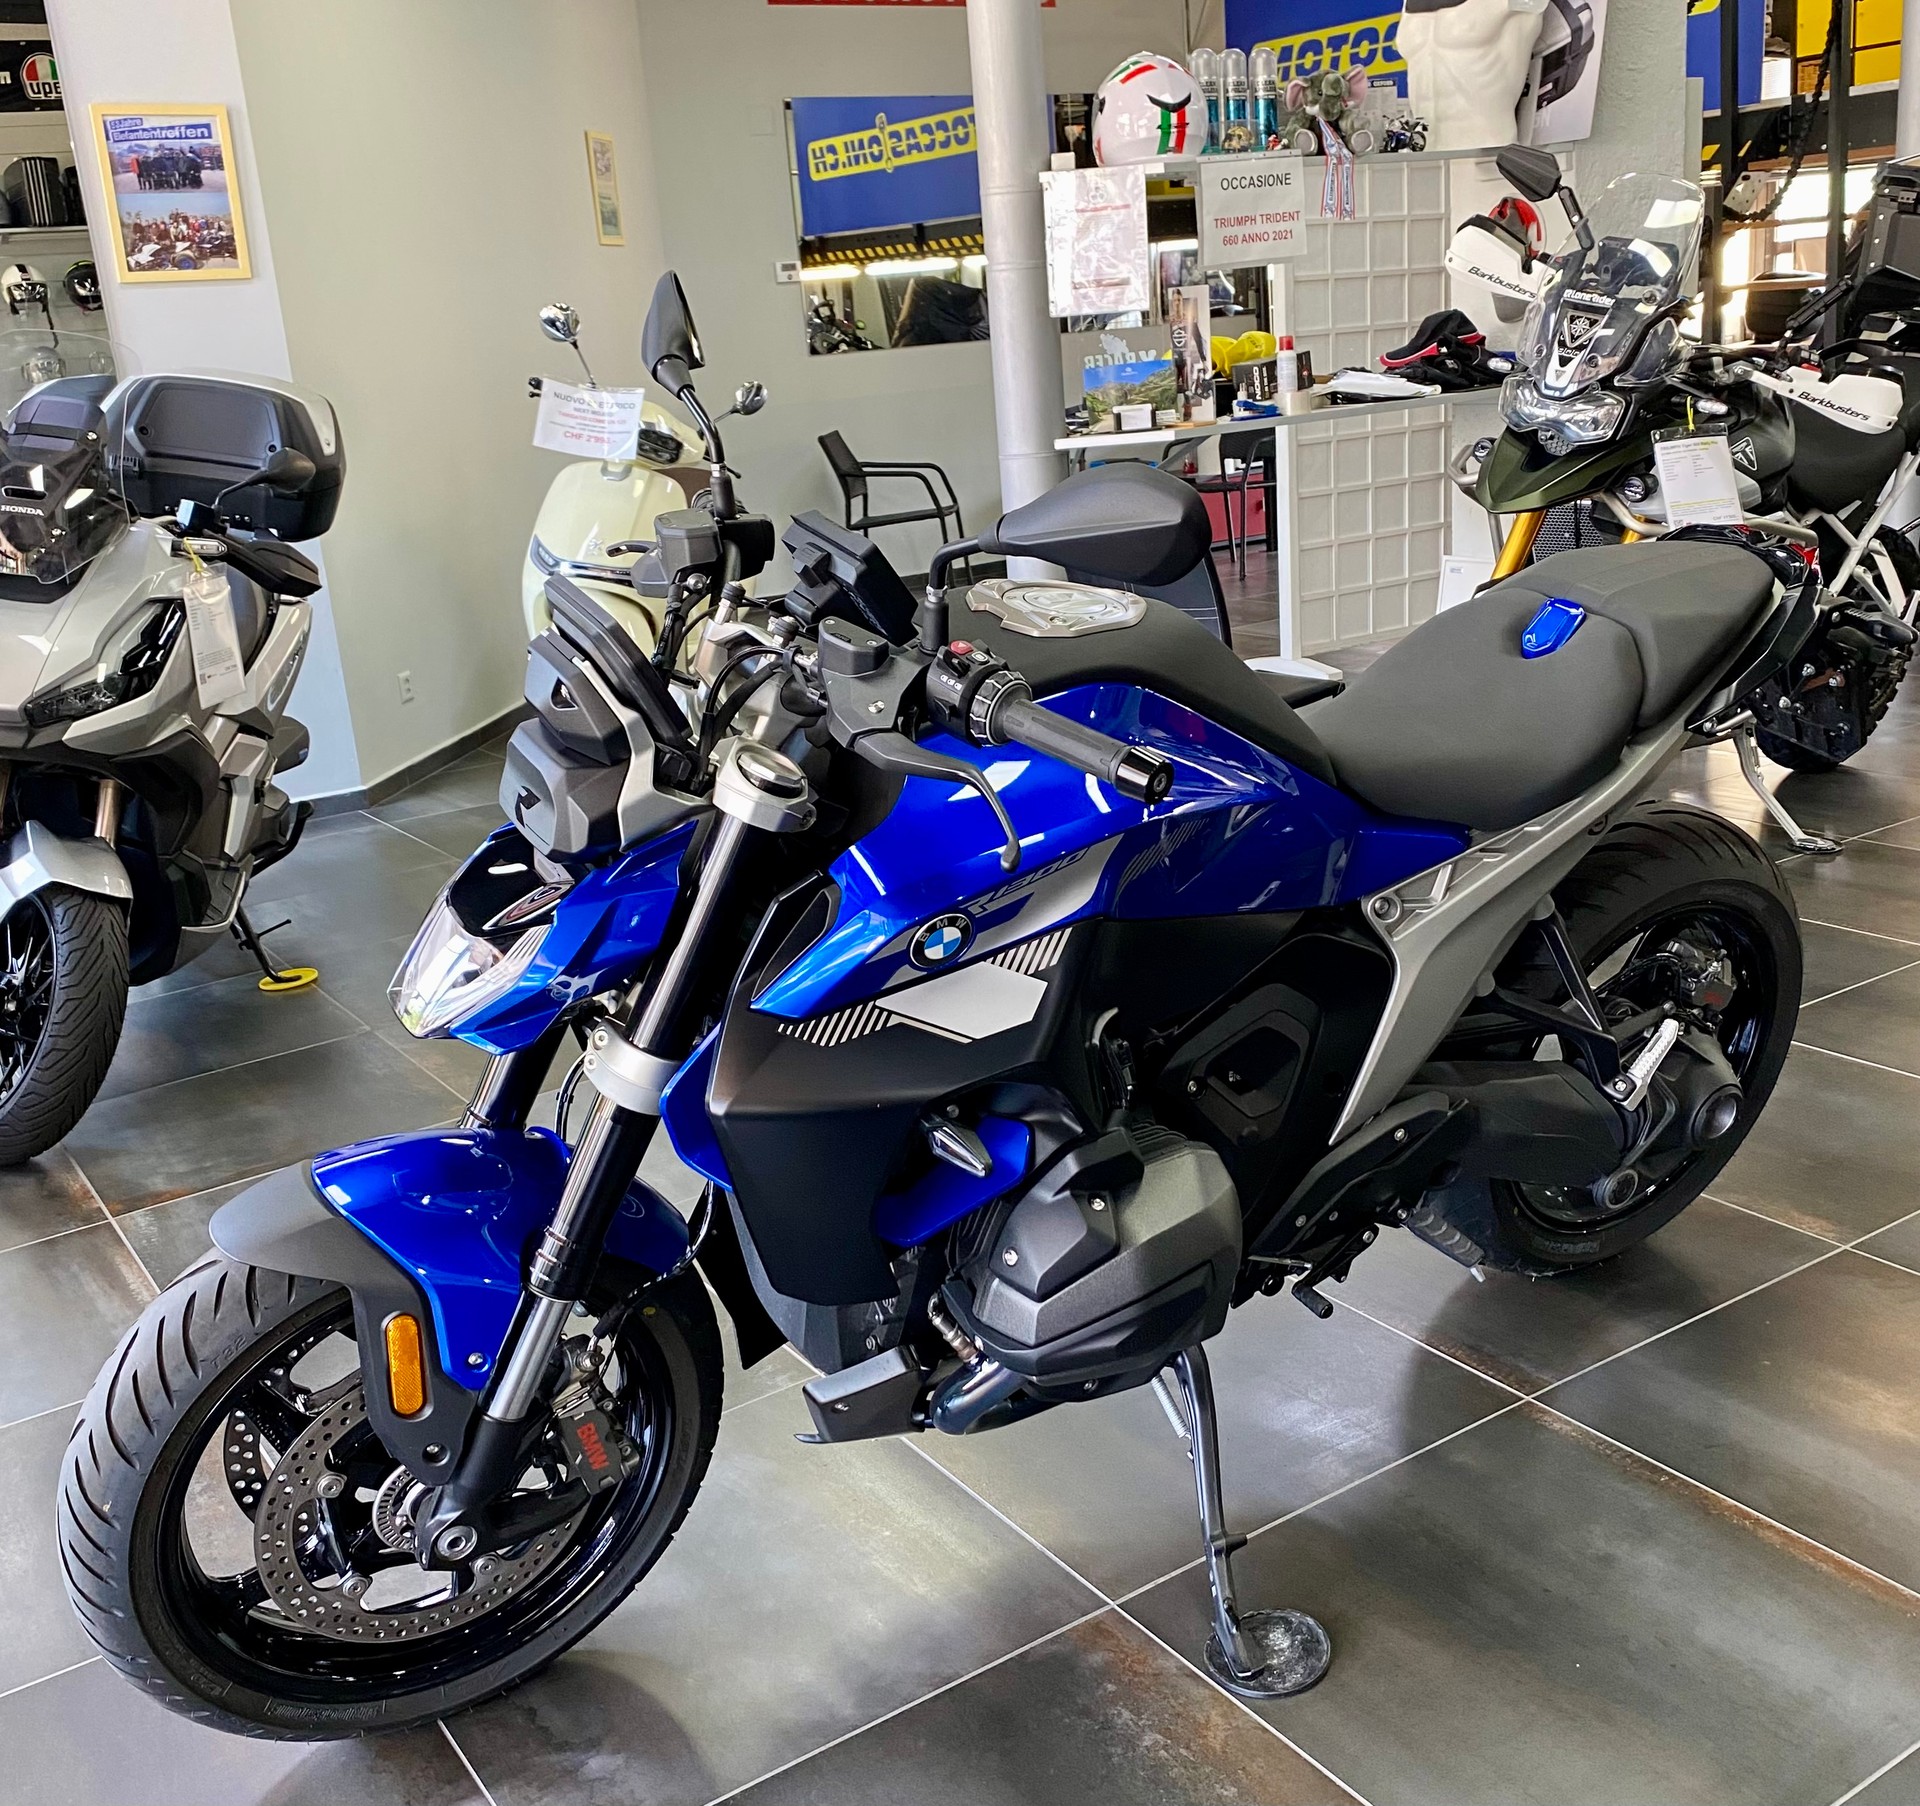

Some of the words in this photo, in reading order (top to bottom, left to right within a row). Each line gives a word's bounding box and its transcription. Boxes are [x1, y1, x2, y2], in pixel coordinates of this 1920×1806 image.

[1220, 173, 1292, 191] OCCASIONE
[1214, 214, 1257, 229] TRIUMPH
[1259, 210, 1301, 226] TRIDENT
[1222, 235, 1239, 246] 660
[1241, 231, 1270, 244] ANNO
[1272, 229, 1294, 241] 2021
[1467, 266, 1537, 299] Barkbusters
[1252, 366, 1262, 400] NOCO
[553, 391, 586, 405] NUOVO
[1797, 391, 1872, 421] Barkbusters
[1, 504, 45, 516] HONDA
[917, 917, 968, 943] BMW
[577, 1422, 610, 1470] BMW
